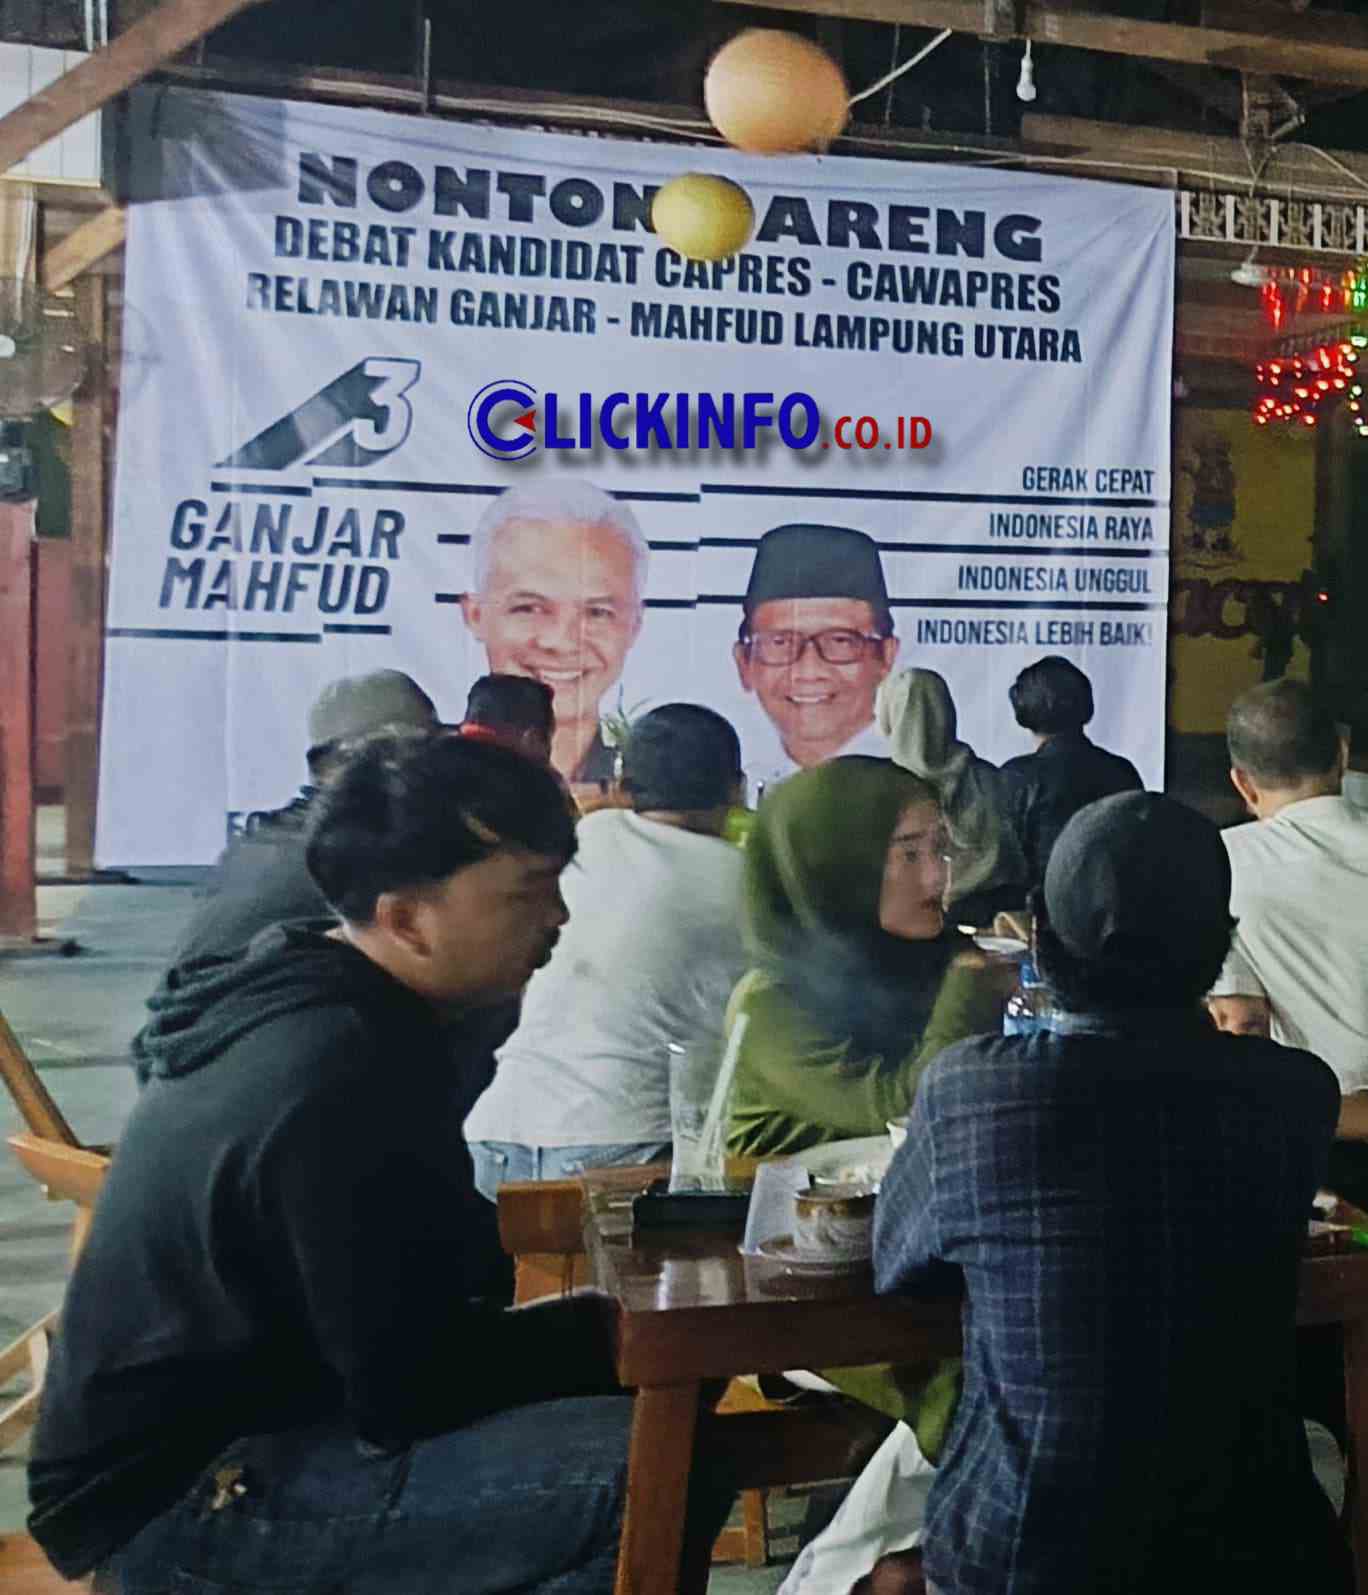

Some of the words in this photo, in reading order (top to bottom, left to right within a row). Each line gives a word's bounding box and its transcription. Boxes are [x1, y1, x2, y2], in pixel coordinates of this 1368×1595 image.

[298, 153, 658, 235] NONTON
[755, 195, 1043, 263] ARENG
[275, 216, 416, 267] DEBAT
[428, 230, 643, 286] KANDIDAT
[654, 249, 811, 297] CAPRES
[846, 262, 1061, 314] CAWAPRES
[246, 272, 438, 326] RELAWAN
[450, 290, 596, 336] GANJAR
[630, 303, 784, 346] MAHFUD
[794, 316, 966, 357] LAMPUNG
[973, 325, 1083, 363] UTARA
[1023, 466, 1089, 493] GERAK
[1095, 469, 1155, 495] CEPAT
[168, 498, 406, 559] GANJAR
[989, 512, 1099, 540] INDONESIA
[1105, 516, 1154, 540] RAYA
[158, 556, 392, 615] MAHFUD
[958, 565, 1068, 593] INDONESIA
[1075, 568, 1152, 593] UNGGUL
[917, 619, 1029, 645] INDONESIA
[1035, 621, 1094, 645] LEBIH
